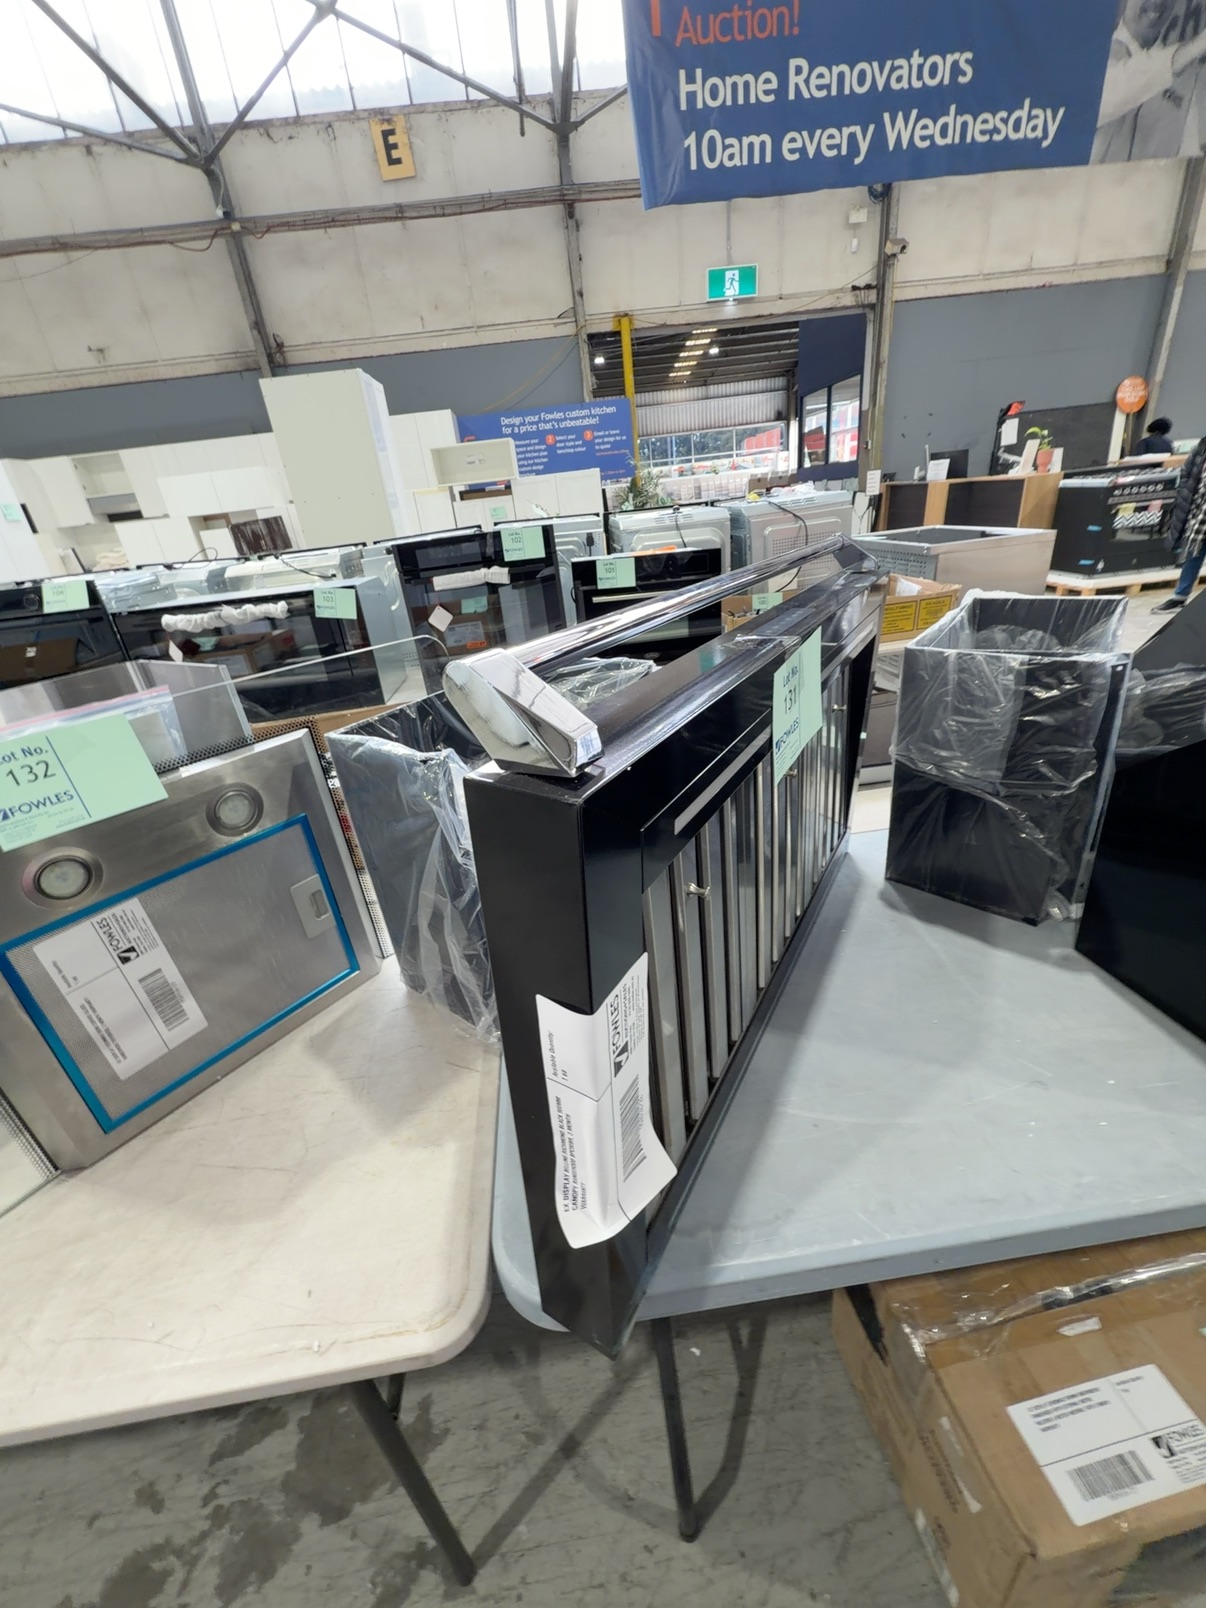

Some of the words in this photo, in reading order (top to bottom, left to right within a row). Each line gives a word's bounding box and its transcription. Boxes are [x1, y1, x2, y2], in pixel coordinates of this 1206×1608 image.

[675, 0, 800, 47] Auction!
[679, 68, 778, 110] Home
[788, 50, 974, 100] Renovators
[381, 128, 403, 166] E
[684, 129, 771, 171] 10am
[782, 122, 875, 166] every
[883, 97, 1066, 151] Wednesday
[501, 416, 523, 425] Design
[524, 414, 539, 424] your
[541, 411, 564, 420] Fowles
[566, 409, 590, 418] custom
[591, 406, 616, 414] kitchen
[520, 425, 537, 434] price
[539, 421, 558, 430] that's
[560, 416, 599, 428] unbeatable!
[784, 685, 797, 714] 131
[781, 717, 798, 744] FOWLES
[0, 751, 19, 766] ot
[21, 746, 48, 758] No.
[6, 760, 56, 786] 132
[9, 790, 74, 817] FOWLES
[96, 917, 123, 951] FOWLES
[610, 994, 621, 1055] FOWLES
[571, 1184, 579, 1211] CANOPY
